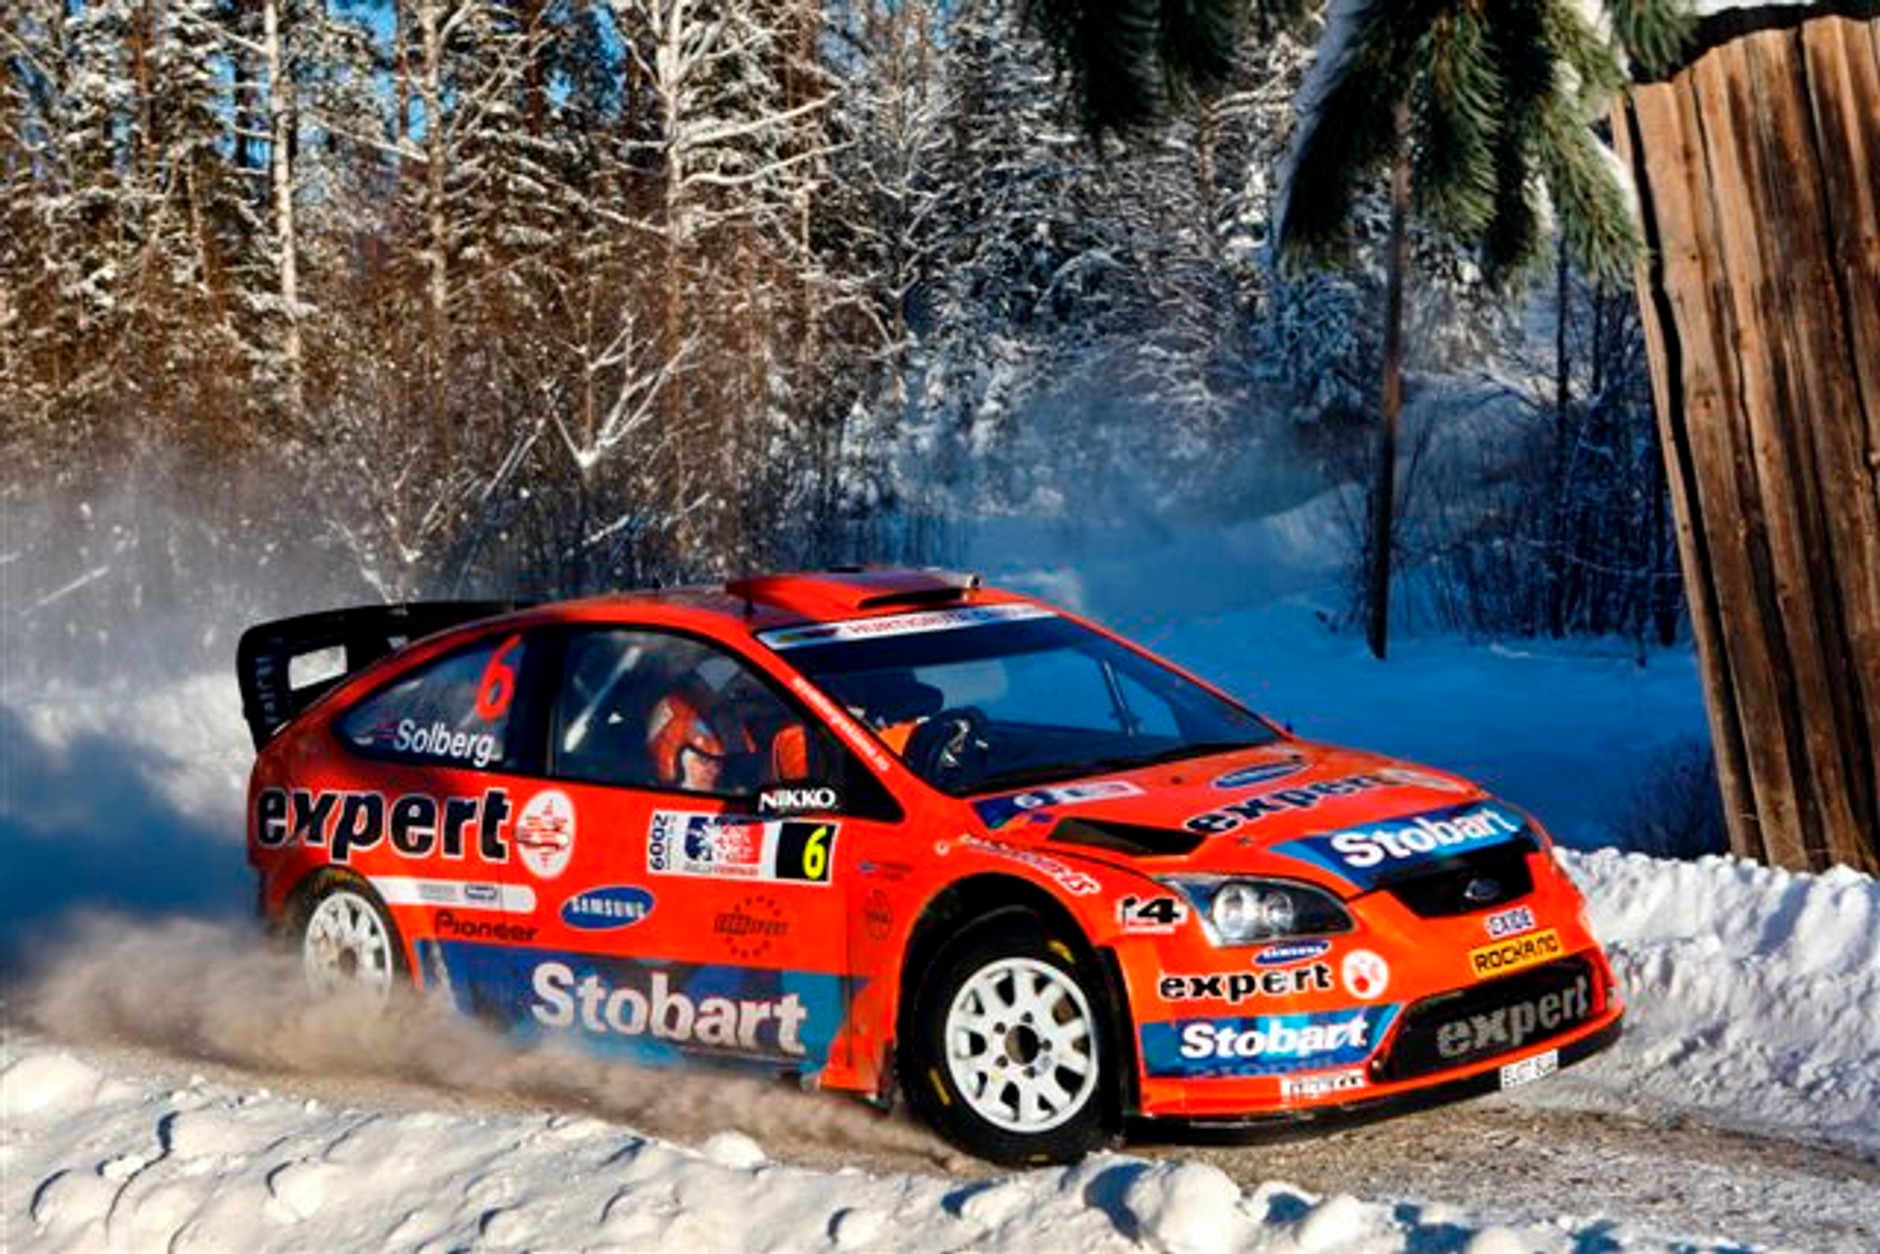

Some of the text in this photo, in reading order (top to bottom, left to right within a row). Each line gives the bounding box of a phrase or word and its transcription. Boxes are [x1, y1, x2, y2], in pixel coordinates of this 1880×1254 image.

[476, 635, 521, 720] 6
[395, 719, 495, 767] Solberg
[254, 787, 512, 863] expert
[758, 788, 836, 812] NIKKO
[649, 814, 668, 870] 2009
[802, 825, 828, 880] 6
[1330, 808, 1518, 867] Stobart
[434, 911, 537, 940] Pioneer
[572, 898, 645, 920] SAMSUNG
[531, 961, 806, 1054] Stobart
[1158, 962, 1334, 1001] expert
[1180, 1014, 1370, 1058] Stobart
[1436, 977, 1587, 1057] expert
